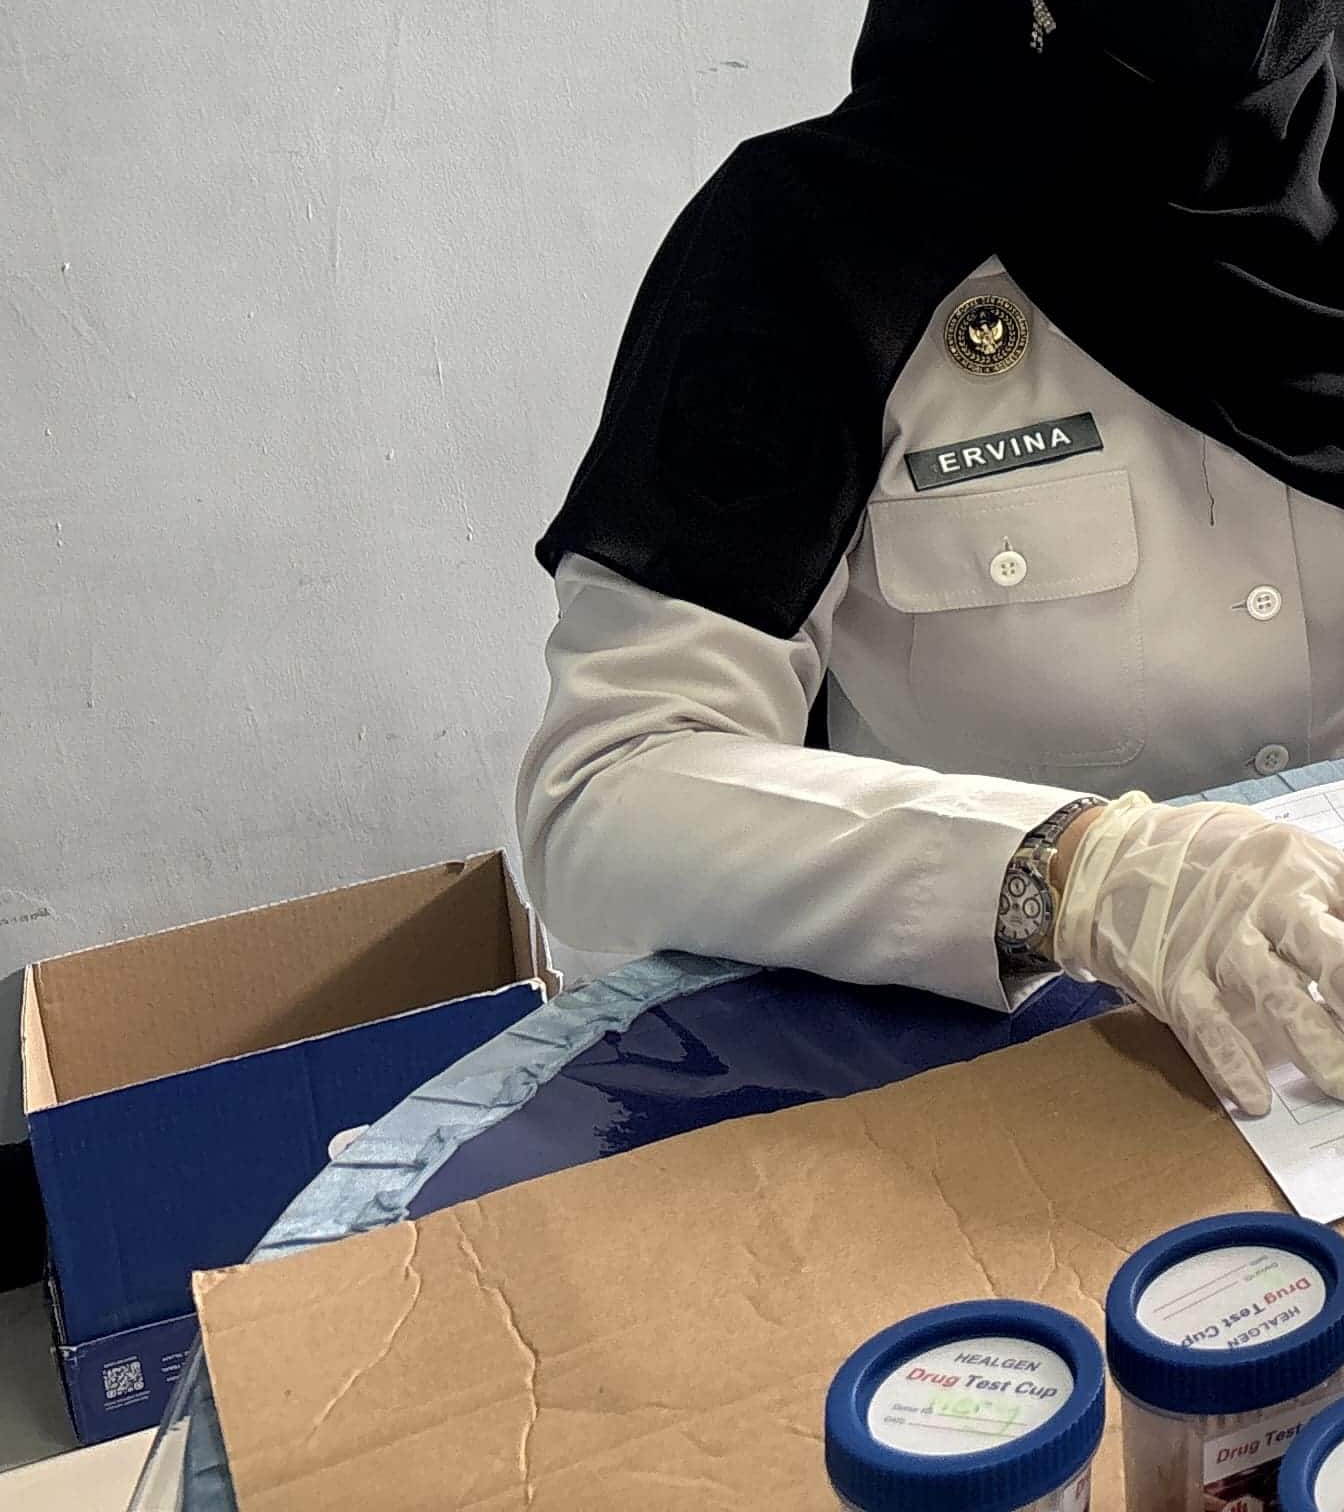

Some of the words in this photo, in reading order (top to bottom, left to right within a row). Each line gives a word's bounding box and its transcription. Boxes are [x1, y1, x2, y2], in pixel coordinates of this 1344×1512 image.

[938, 427, 1072, 473] ERVINA
[1264, 1277, 1312, 1305] Drug
[1222, 1302, 1266, 1328] Test
[1227, 1305, 1301, 1350] HEALGEN
[954, 1352, 1042, 1372] HEALGEN
[906, 1367, 961, 1388] Drug
[964, 1374, 1012, 1392] Test
[1015, 1380, 1059, 1399] Cup
[1216, 1439, 1260, 1464] Drug
